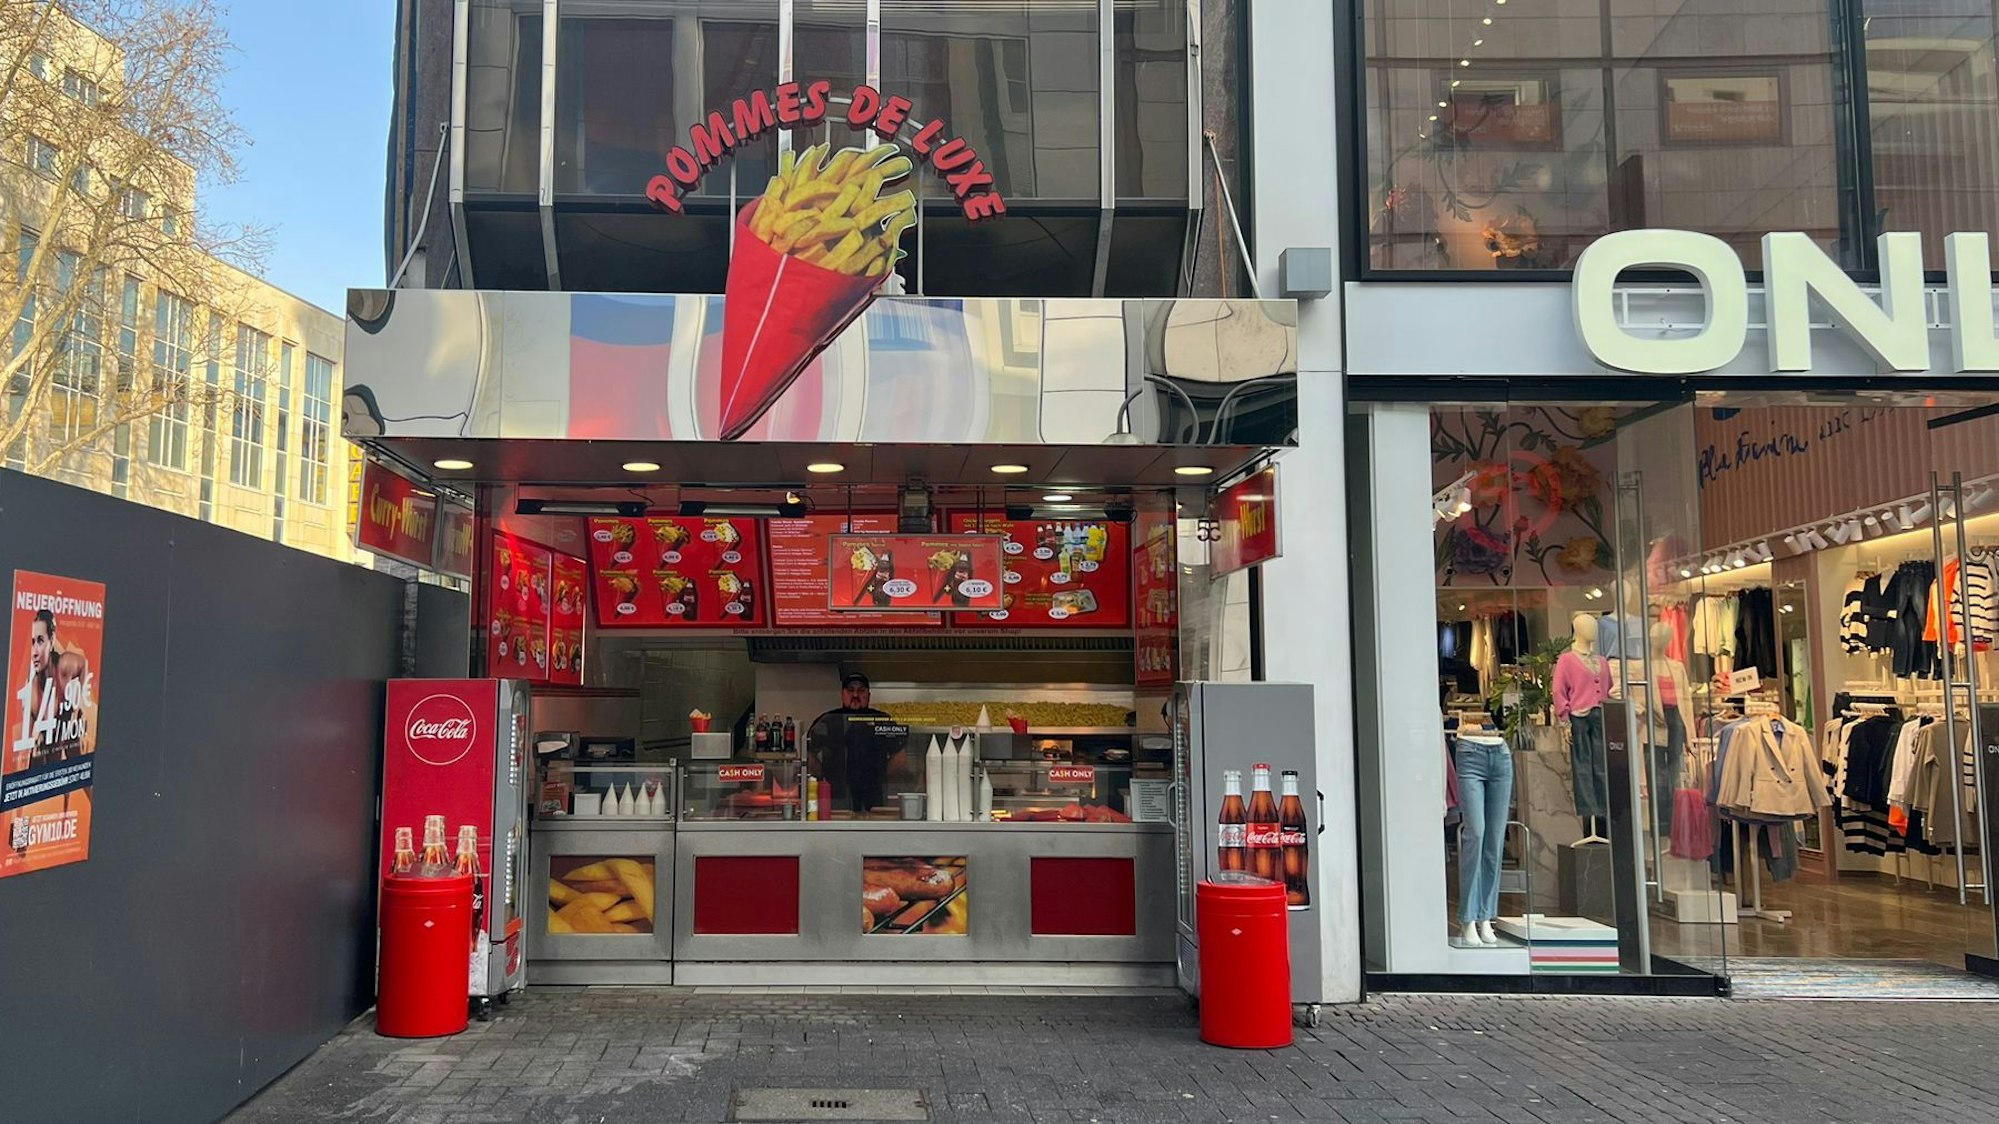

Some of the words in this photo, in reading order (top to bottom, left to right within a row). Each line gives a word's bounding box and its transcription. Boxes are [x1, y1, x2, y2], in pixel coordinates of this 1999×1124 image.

[645, 79, 832, 216] POMMES
[847, 84, 913, 141] DE
[912, 117, 1008, 223] LUXE
[965, 586, 981, 594] 6,10
[16, 590, 103, 619] NEUERÖFFNUNG
[410, 718, 472, 739] Coca-Cola
[742, 769, 763, 777] ONLY
[1072, 769, 1093, 777] ONLY
[28, 818, 78, 846] GYM10.DE
[1246, 831, 1279, 844] Coca-Cola
